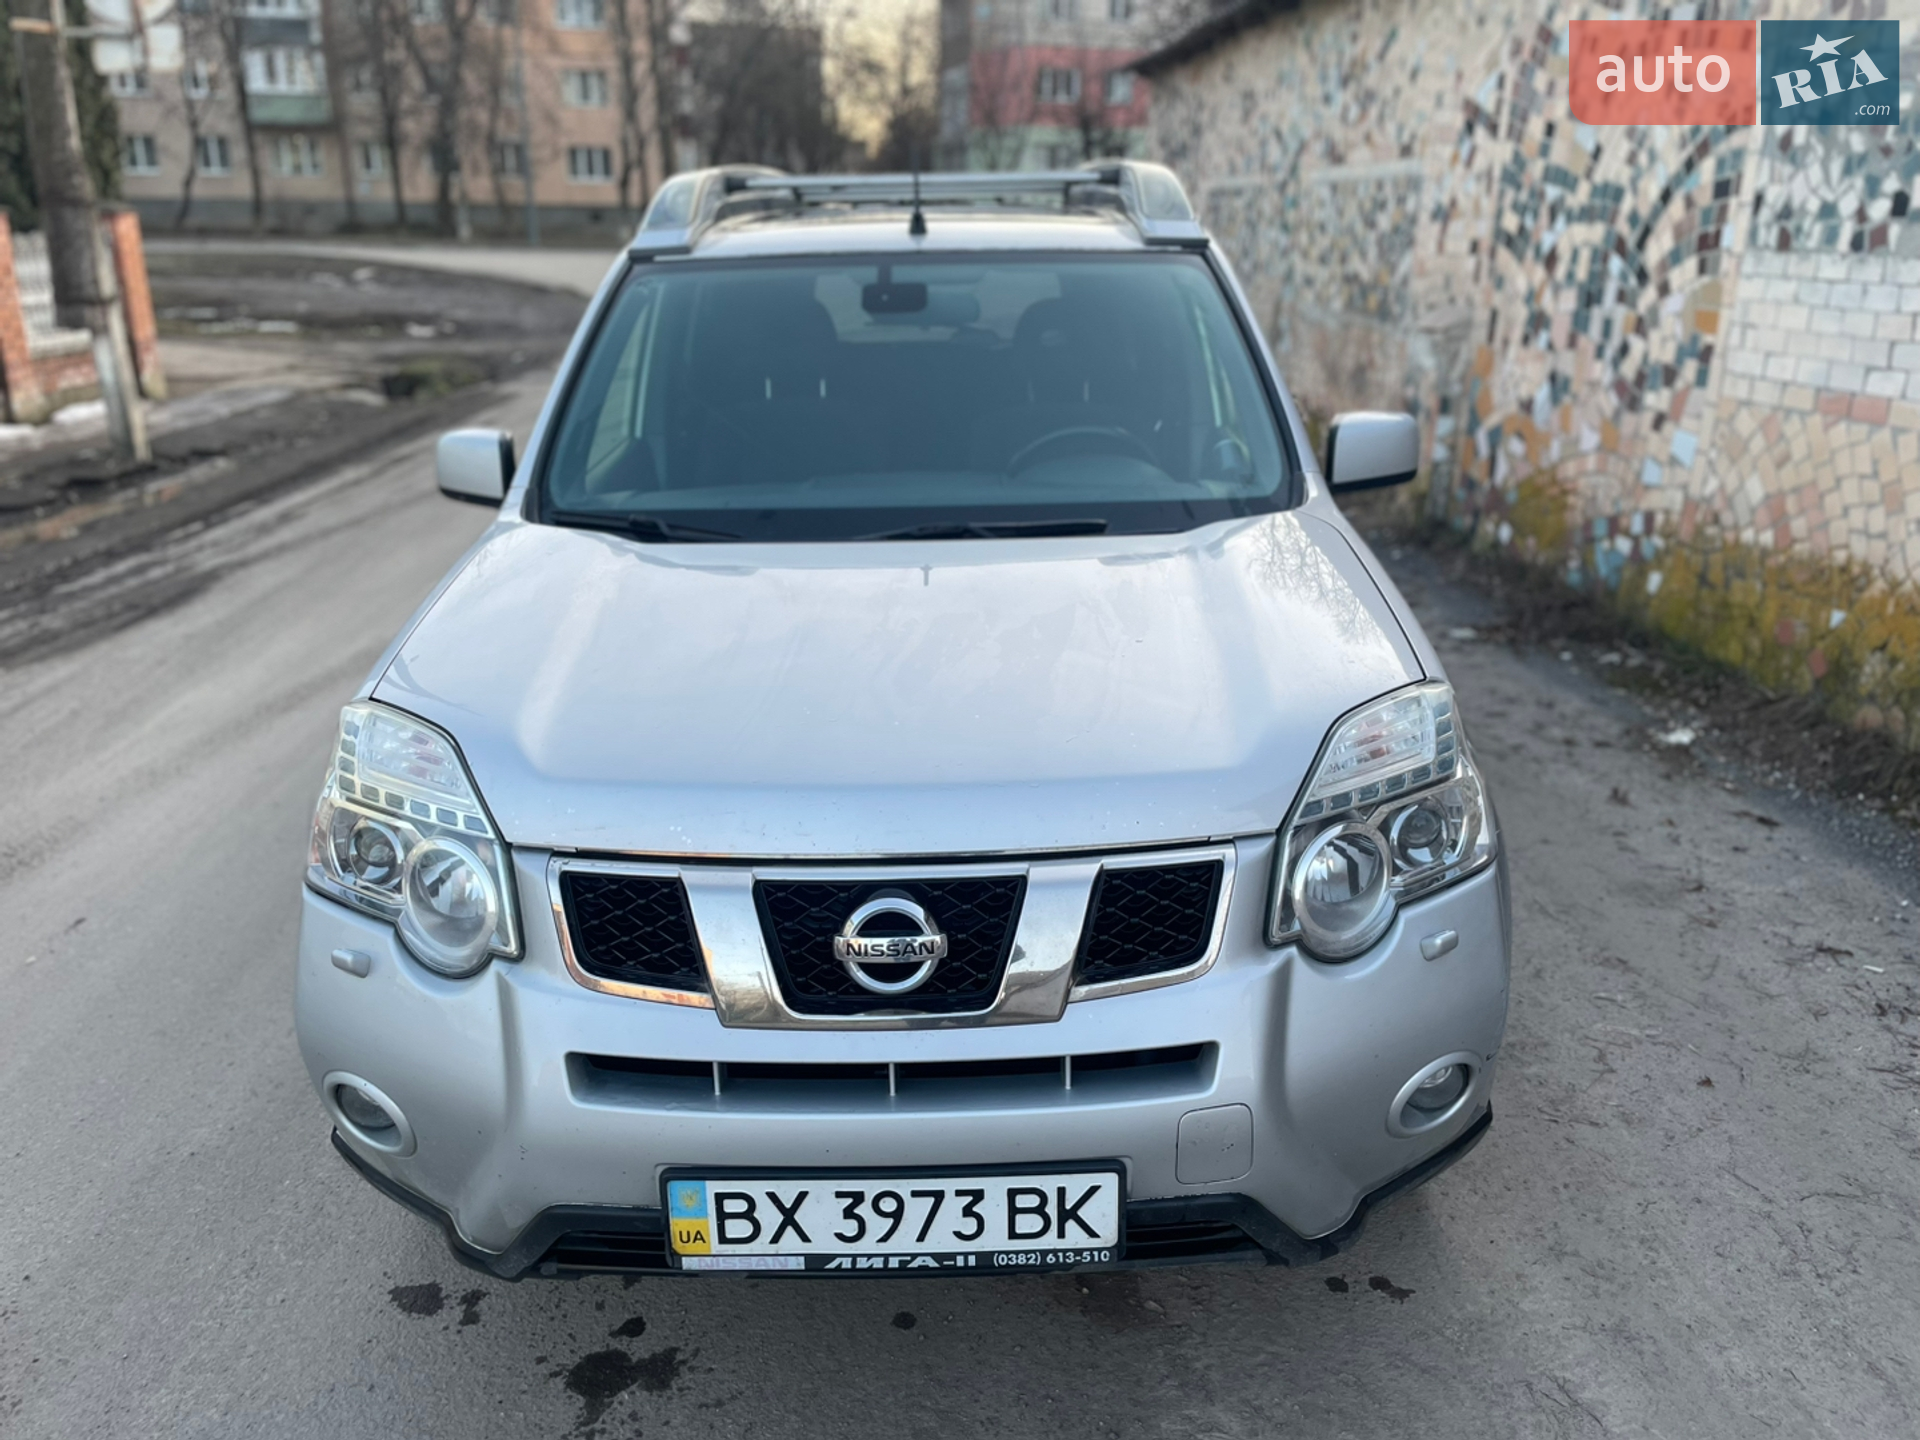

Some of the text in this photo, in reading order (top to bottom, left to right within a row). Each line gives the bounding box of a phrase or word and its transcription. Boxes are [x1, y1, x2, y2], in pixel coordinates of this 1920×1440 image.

[846, 942, 935, 957] NISSAN
[714, 1184, 1103, 1245] BX 3973 BK
[678, 1230, 707, 1245] UA
[698, 1256, 790, 1269] NISSAN
[993, 1251, 1042, 1266] (0382)
[1046, 1250, 1110, 1263] 613-510
